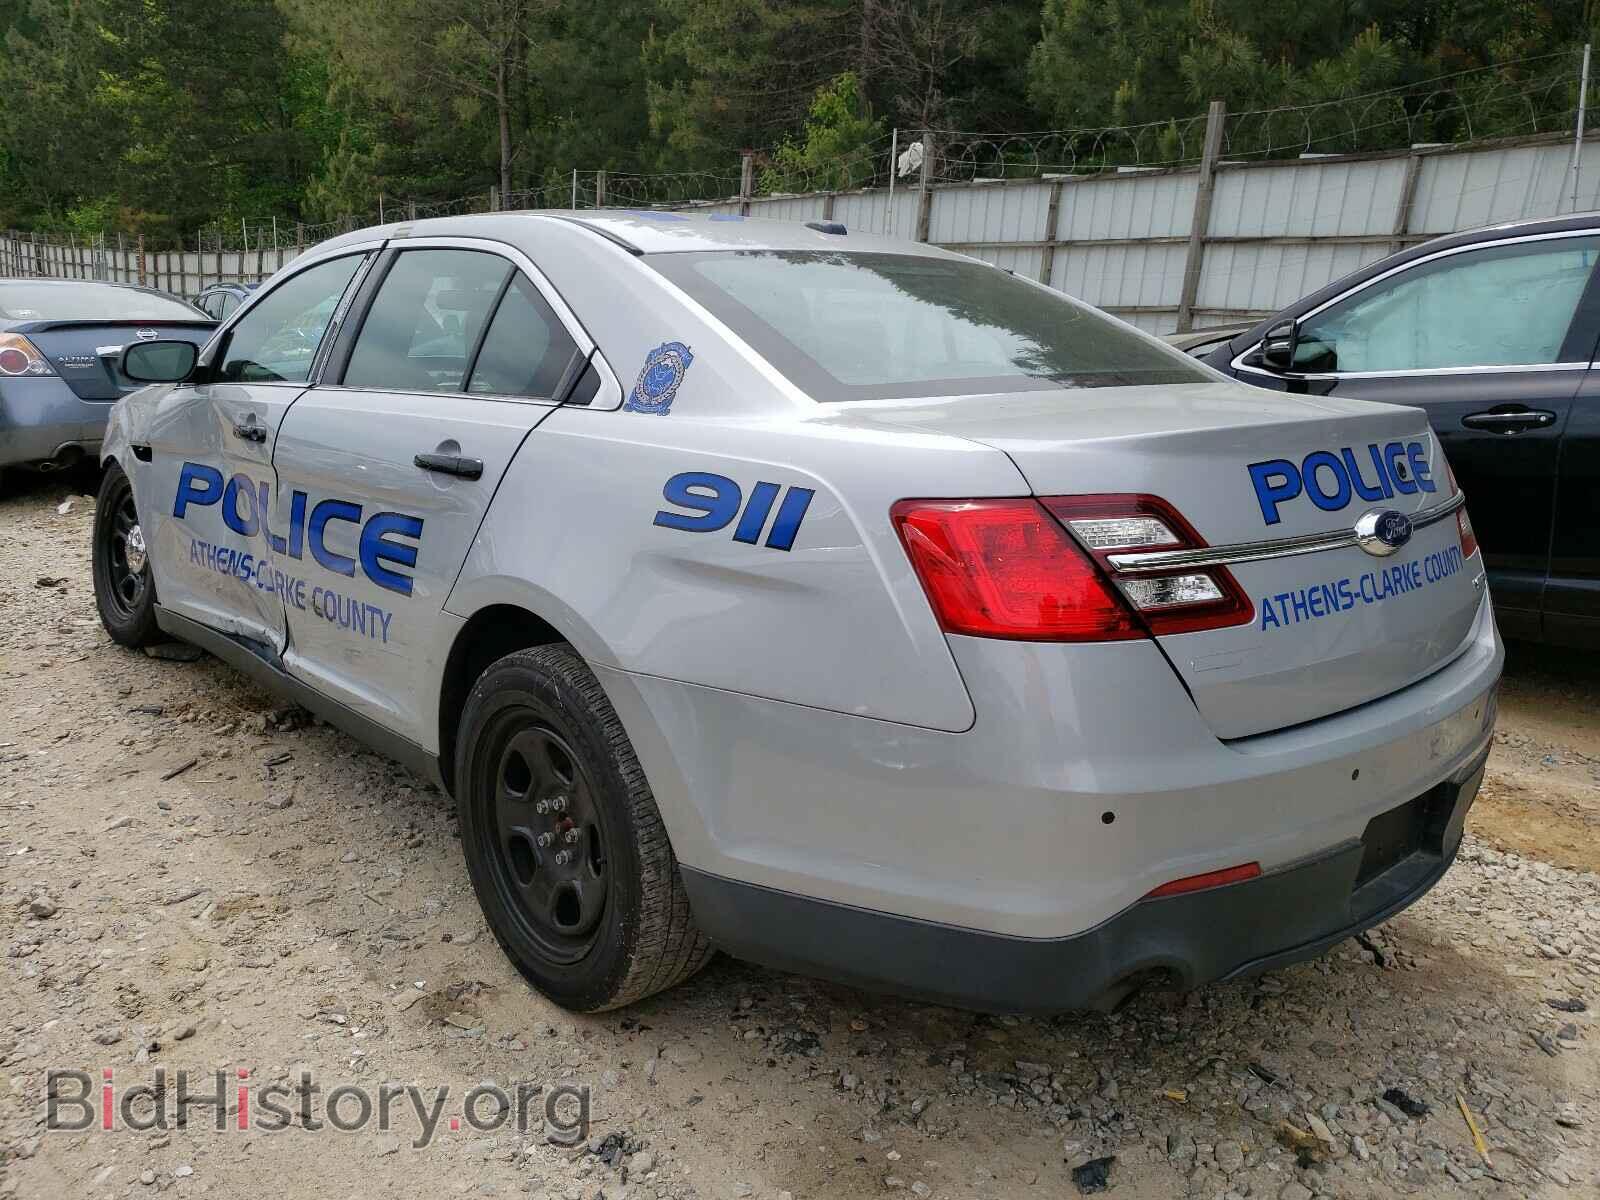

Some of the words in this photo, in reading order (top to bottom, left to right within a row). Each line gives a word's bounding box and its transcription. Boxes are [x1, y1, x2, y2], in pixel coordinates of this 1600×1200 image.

[653, 472, 816, 552] 911
[1248, 442, 1436, 525] POLICE
[173, 462, 424, 597] POLICE
[1385, 515, 1408, 540] Ford
[190, 539, 306, 611] ATHENS-CLRKE
[312, 587, 393, 643] COUNTY
[1261, 561, 1423, 631] ATHENS-CLARKE
[1424, 545, 1464, 583] COUNTY
